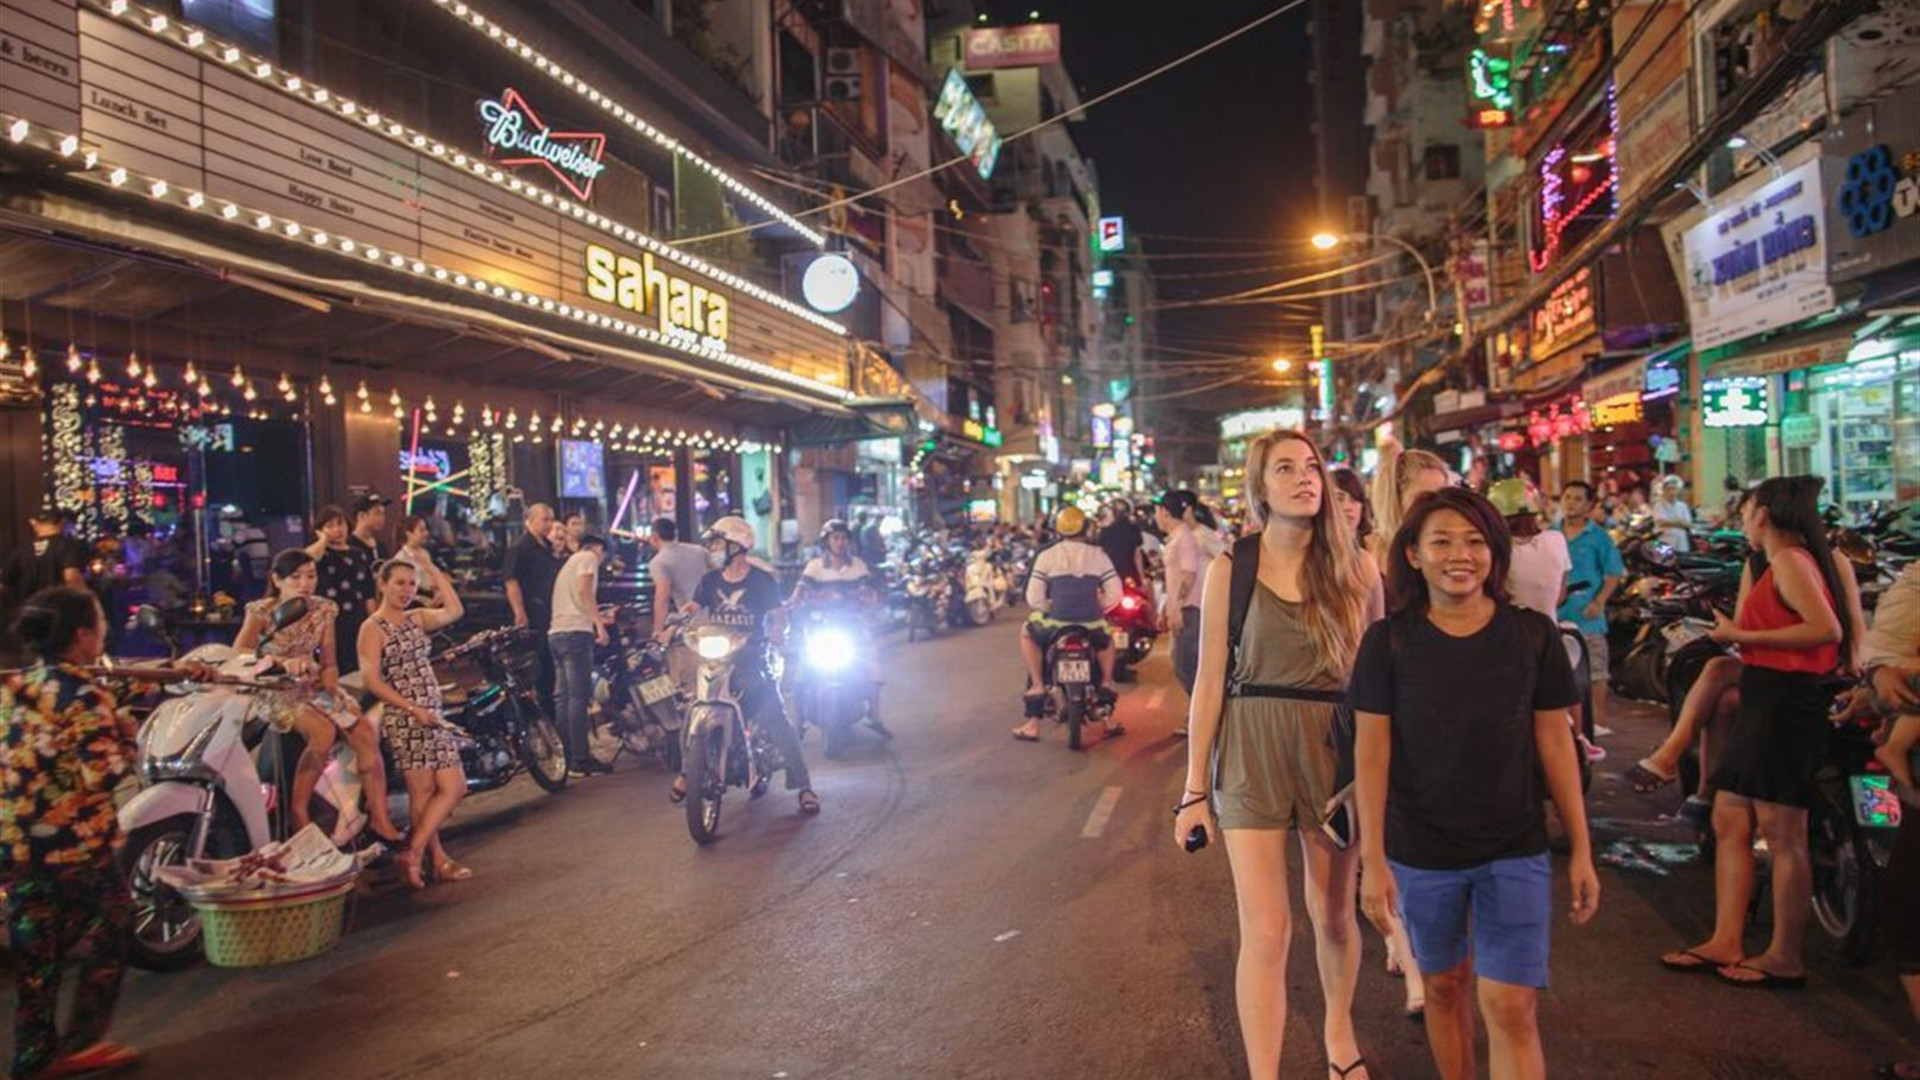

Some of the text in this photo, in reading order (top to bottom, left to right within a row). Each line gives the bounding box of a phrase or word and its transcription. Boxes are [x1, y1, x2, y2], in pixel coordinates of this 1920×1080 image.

[969, 32, 1054, 55] CASITA
[90, 90, 168, 129] Lunch Set
[479, 99, 605, 179] Budweiser
[288, 183, 322, 207] Happy
[586, 244, 728, 338] sahara
